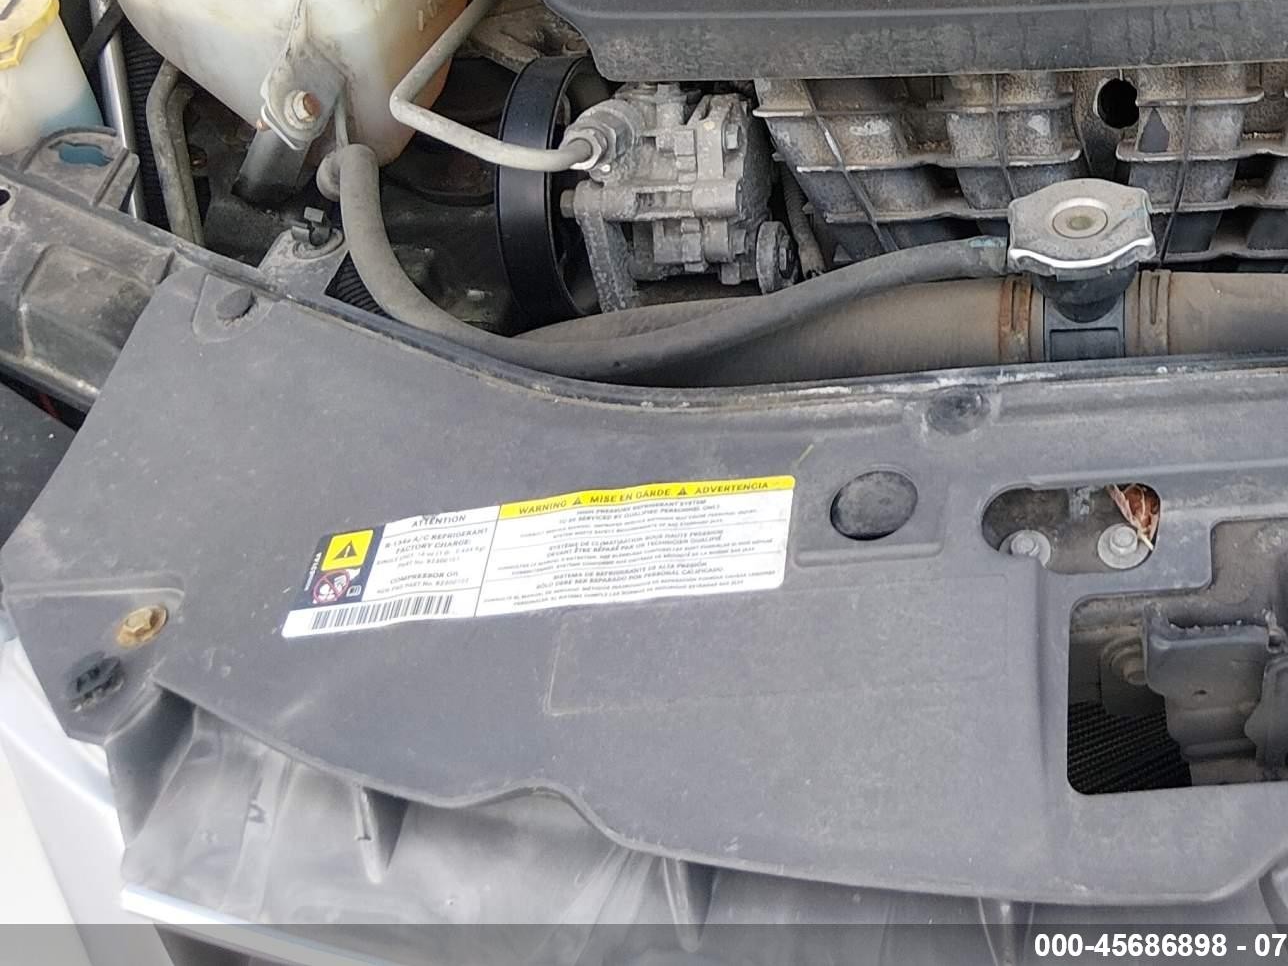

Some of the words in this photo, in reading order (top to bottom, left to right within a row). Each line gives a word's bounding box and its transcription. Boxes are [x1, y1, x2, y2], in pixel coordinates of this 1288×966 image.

[519, 500, 567, 514] WARNING
[590, 494, 617, 504] MISE
[620, 493, 633, 502] EN
[635, 489, 671, 499] GARDE
[695, 482, 769, 494] ADVERTENCIA
[411, 515, 467, 528] ATTENTION
